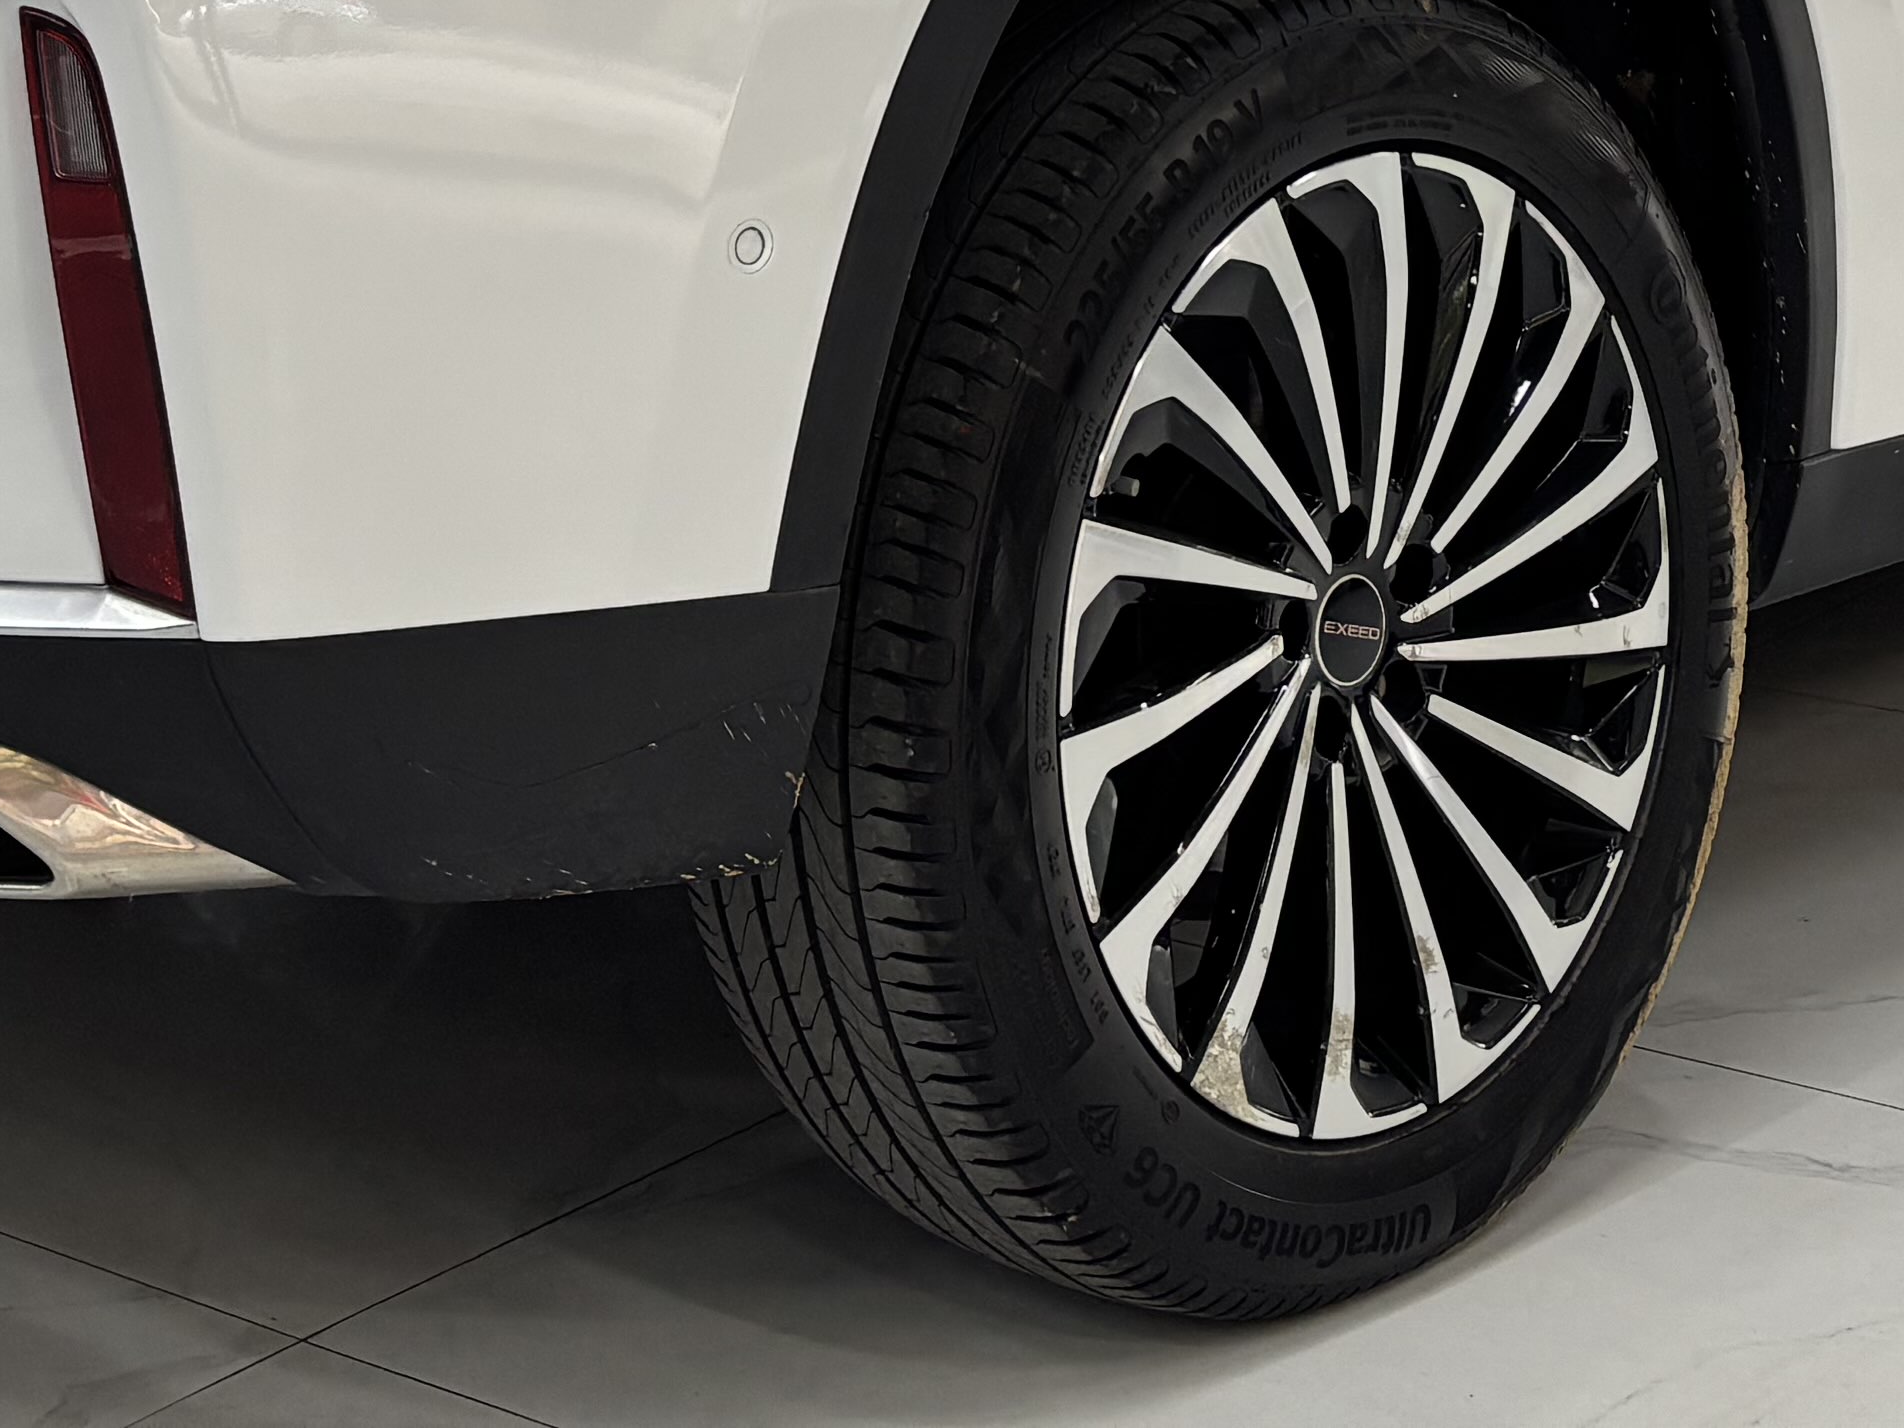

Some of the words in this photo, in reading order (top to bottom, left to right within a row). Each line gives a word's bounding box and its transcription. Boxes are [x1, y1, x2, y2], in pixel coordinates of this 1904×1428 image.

[1323, 620, 1380, 640] EXEED
[1123, 1146, 1200, 1230] UC6
[1205, 1200, 1431, 1268] UltraContact
